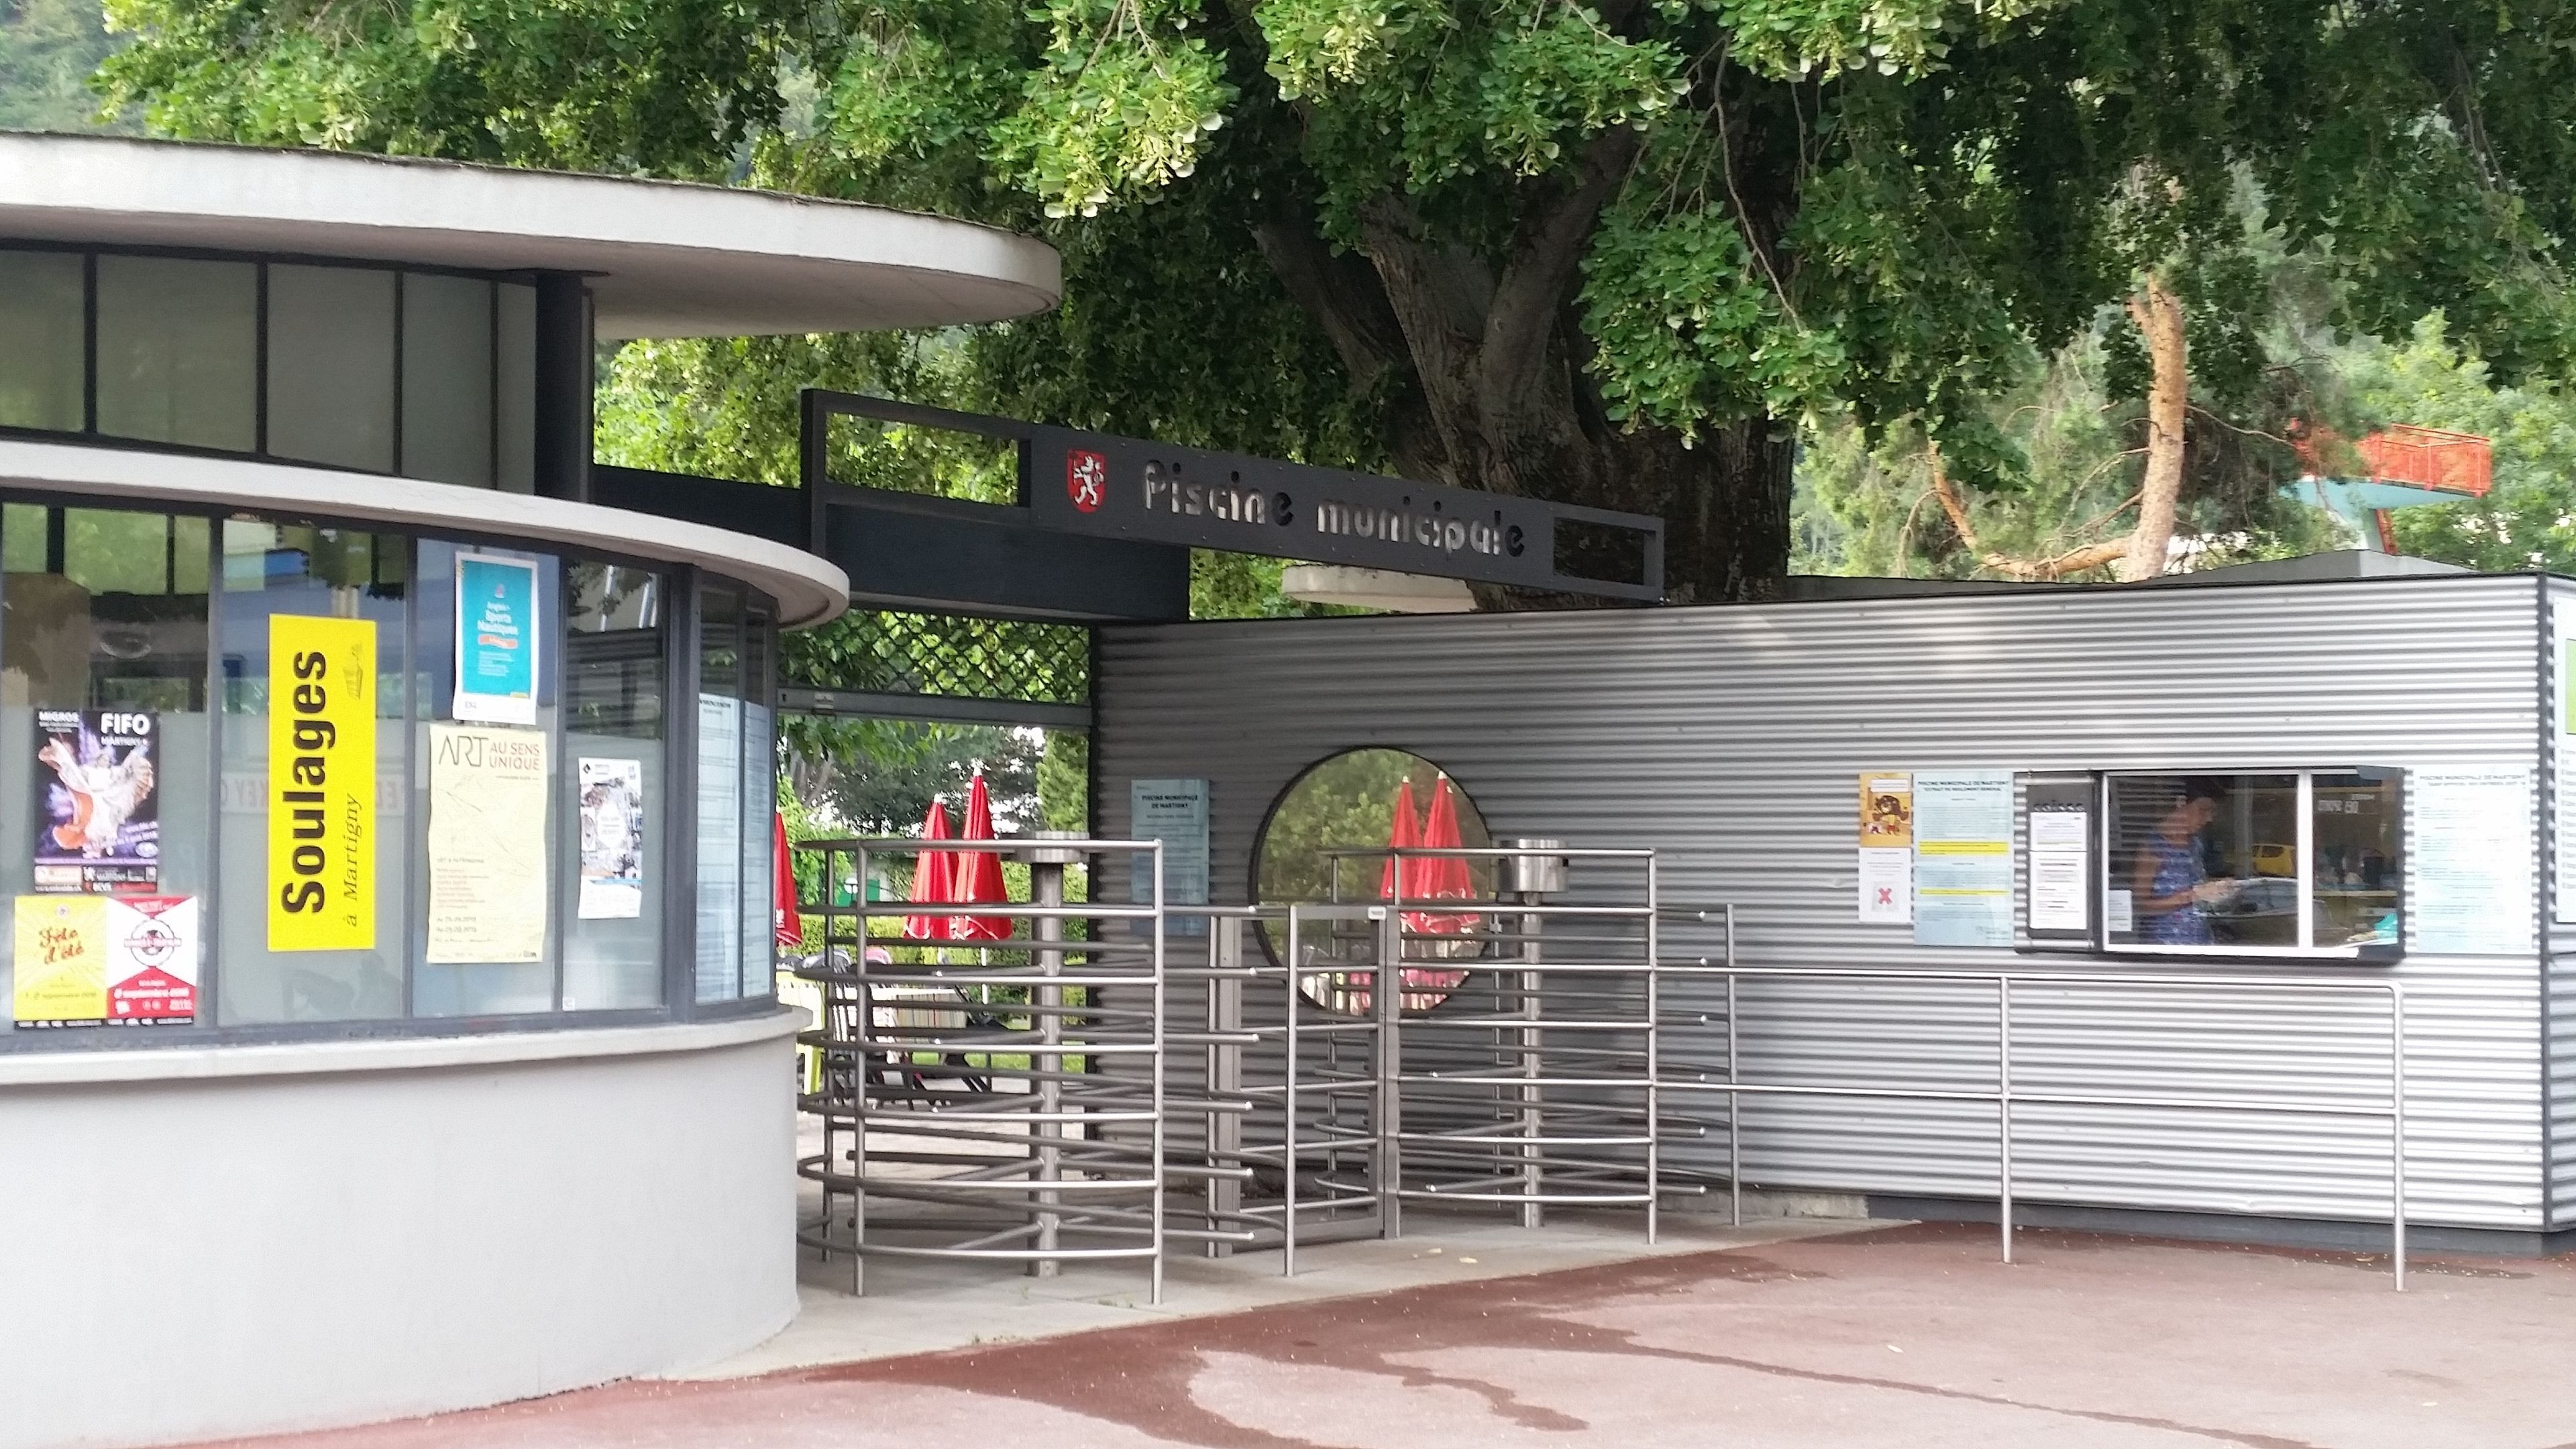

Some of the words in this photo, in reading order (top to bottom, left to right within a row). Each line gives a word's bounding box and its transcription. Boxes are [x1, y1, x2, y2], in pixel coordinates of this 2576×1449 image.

[1144, 459, 1294, 527] Piscine
[1316, 495, 1525, 559] municipale
[101, 712, 150, 735] FIFO
[438, 735, 489, 767] ART
[490, 741, 507, 755] AU
[511, 742, 540, 756] SENS
[489, 755, 540, 771] UNIQUE
[282, 650, 335, 913] Soulages
[343, 793, 364, 902] Martigny
[342, 913, 358, 928] à
